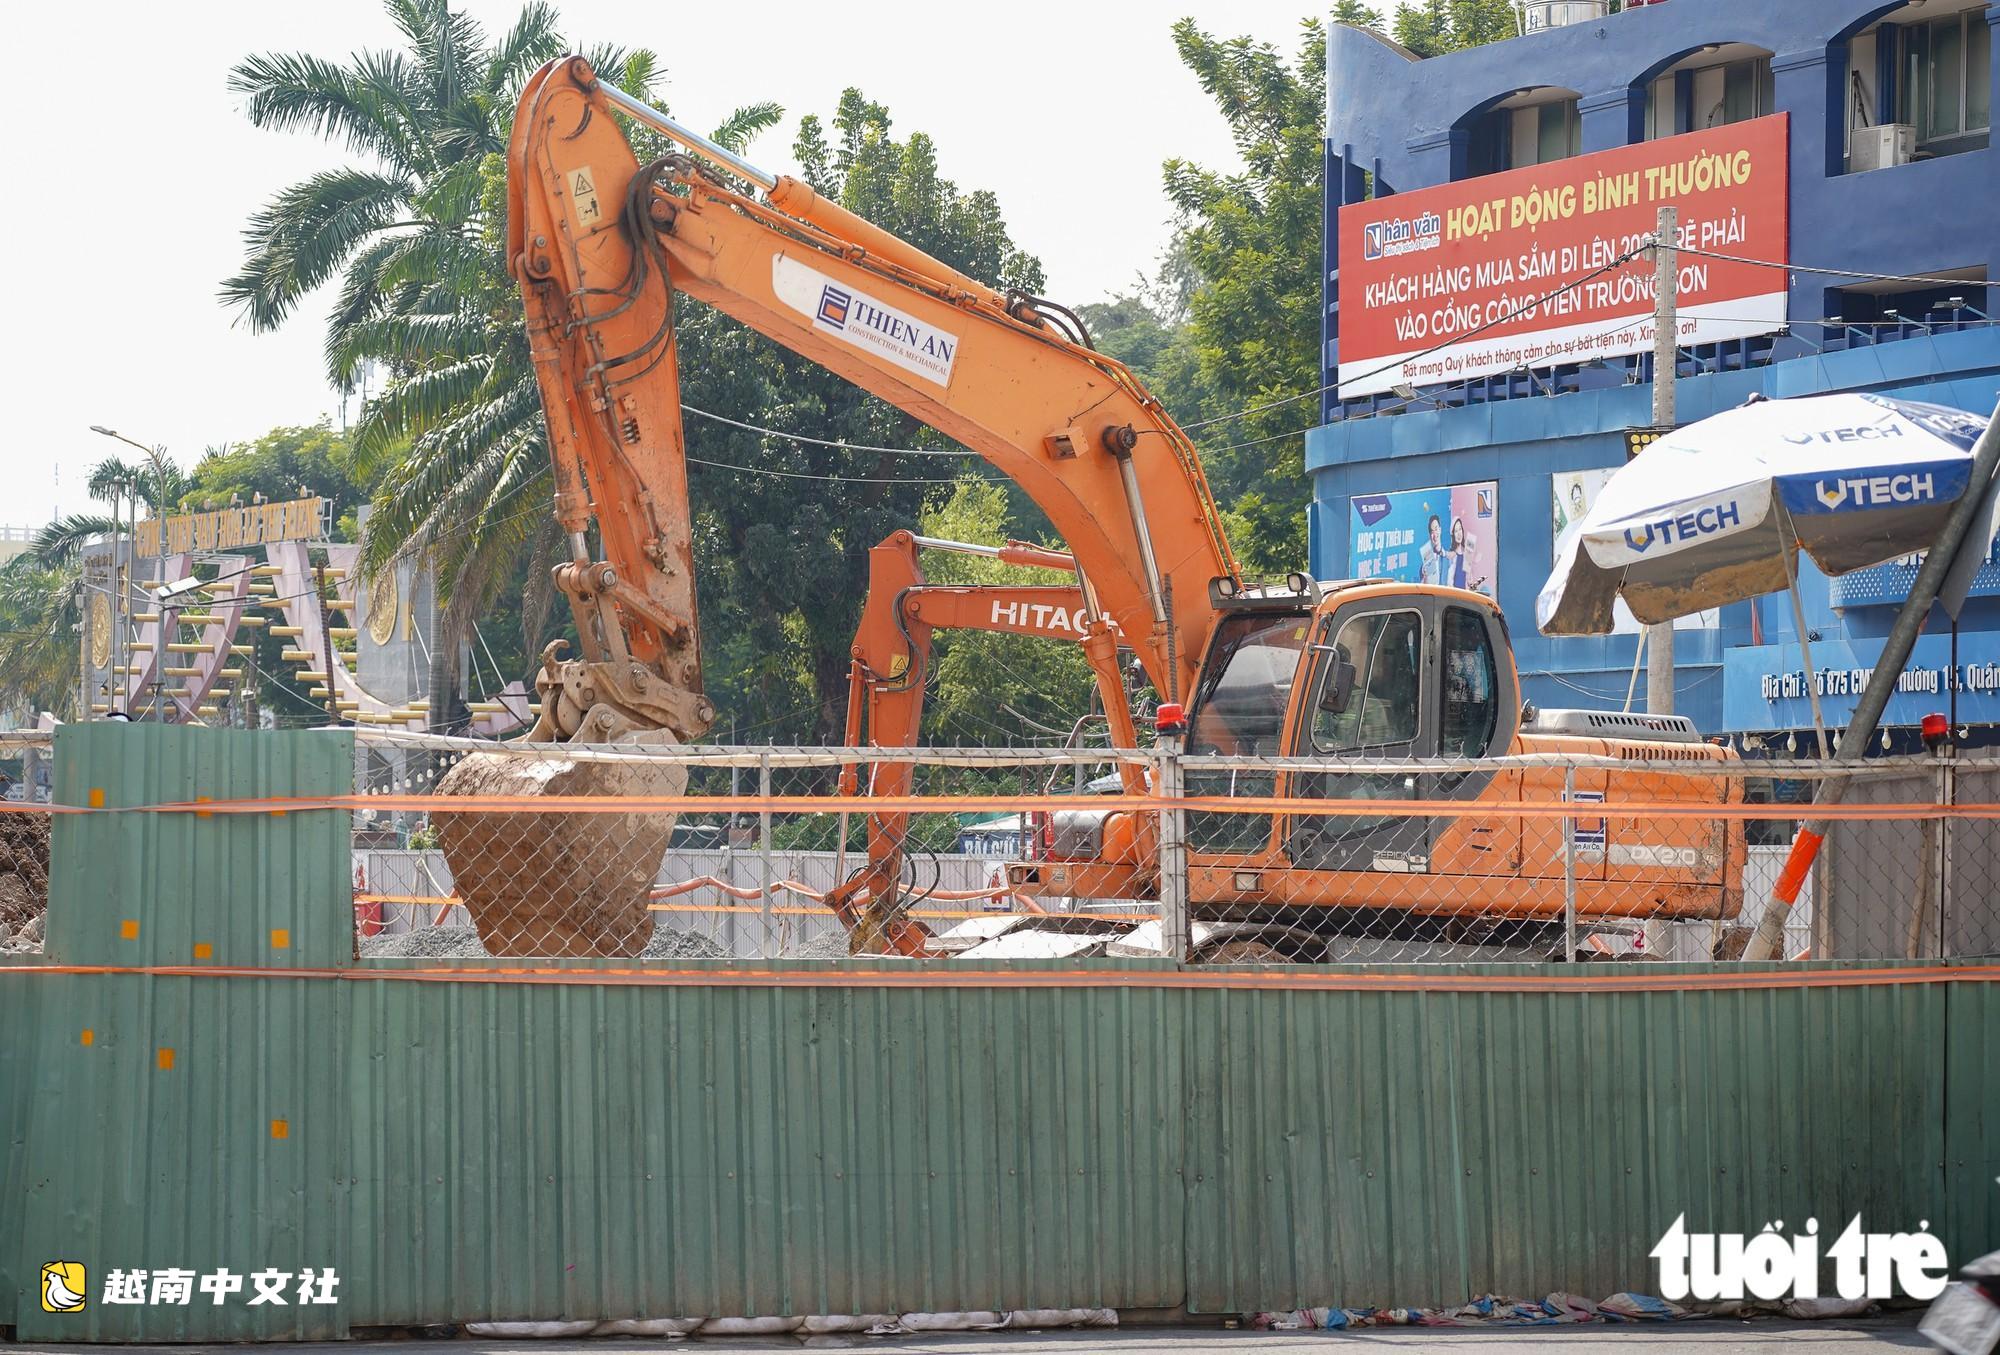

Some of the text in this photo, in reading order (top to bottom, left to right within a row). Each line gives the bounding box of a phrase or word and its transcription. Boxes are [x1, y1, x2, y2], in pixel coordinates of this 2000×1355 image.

[1414, 213, 1441, 237] văn
[1447, 149, 1752, 242] HOẠT ĐỘNG BÌNH THƯỜNG
[1365, 274, 1419, 309] KHÁCH
[1423, 265, 1472, 299] HÀNG
[1476, 249, 1515, 290] MUA
[1518, 242, 1557, 282] SẮM
[1561, 246, 1578, 274] ĐI
[1583, 236, 1616, 270] LÊN
[1701, 207, 1747, 250] PHẢI
[854, 300, 954, 363] THIEN AN
[1395, 310, 1428, 342] VÀO
[1431, 298, 1482, 334] CỔNG
[1486, 293, 1537, 327] CÔNG
[1541, 283, 1582, 317] VIÊN
[1675, 264, 1708, 298] ƠN
[848, 324, 947, 376] CONSTRUCTION & MECHANICAL
[1403, 363, 1418, 379] Rất
[1419, 360, 1443, 376] mong
[1445, 354, 1464, 375] Quý
[1466, 350, 1493, 370] khách
[1495, 345, 1522, 366] thông
[1524, 343, 1544, 362] cảm
[1545, 340, 1563, 357] cho
[1564, 340, 1576, 356] sự
[1578, 332, 1594, 351] bất
[1596, 333, 1615, 350] tiện
[1617, 330, 1636, 348] này.
[1640, 325, 1655, 342] Xin
[1681, 318, 1697, 336] ơn!
[991, 600, 1125, 638] HITACH
[1762, 674, 1779, 704] Địa
[1782, 669, 1802, 698] Chỉ
[1814, 667, 1827, 696] ố
[1827, 670, 1848, 696] 875
[1897, 666, 1938, 694] hường
